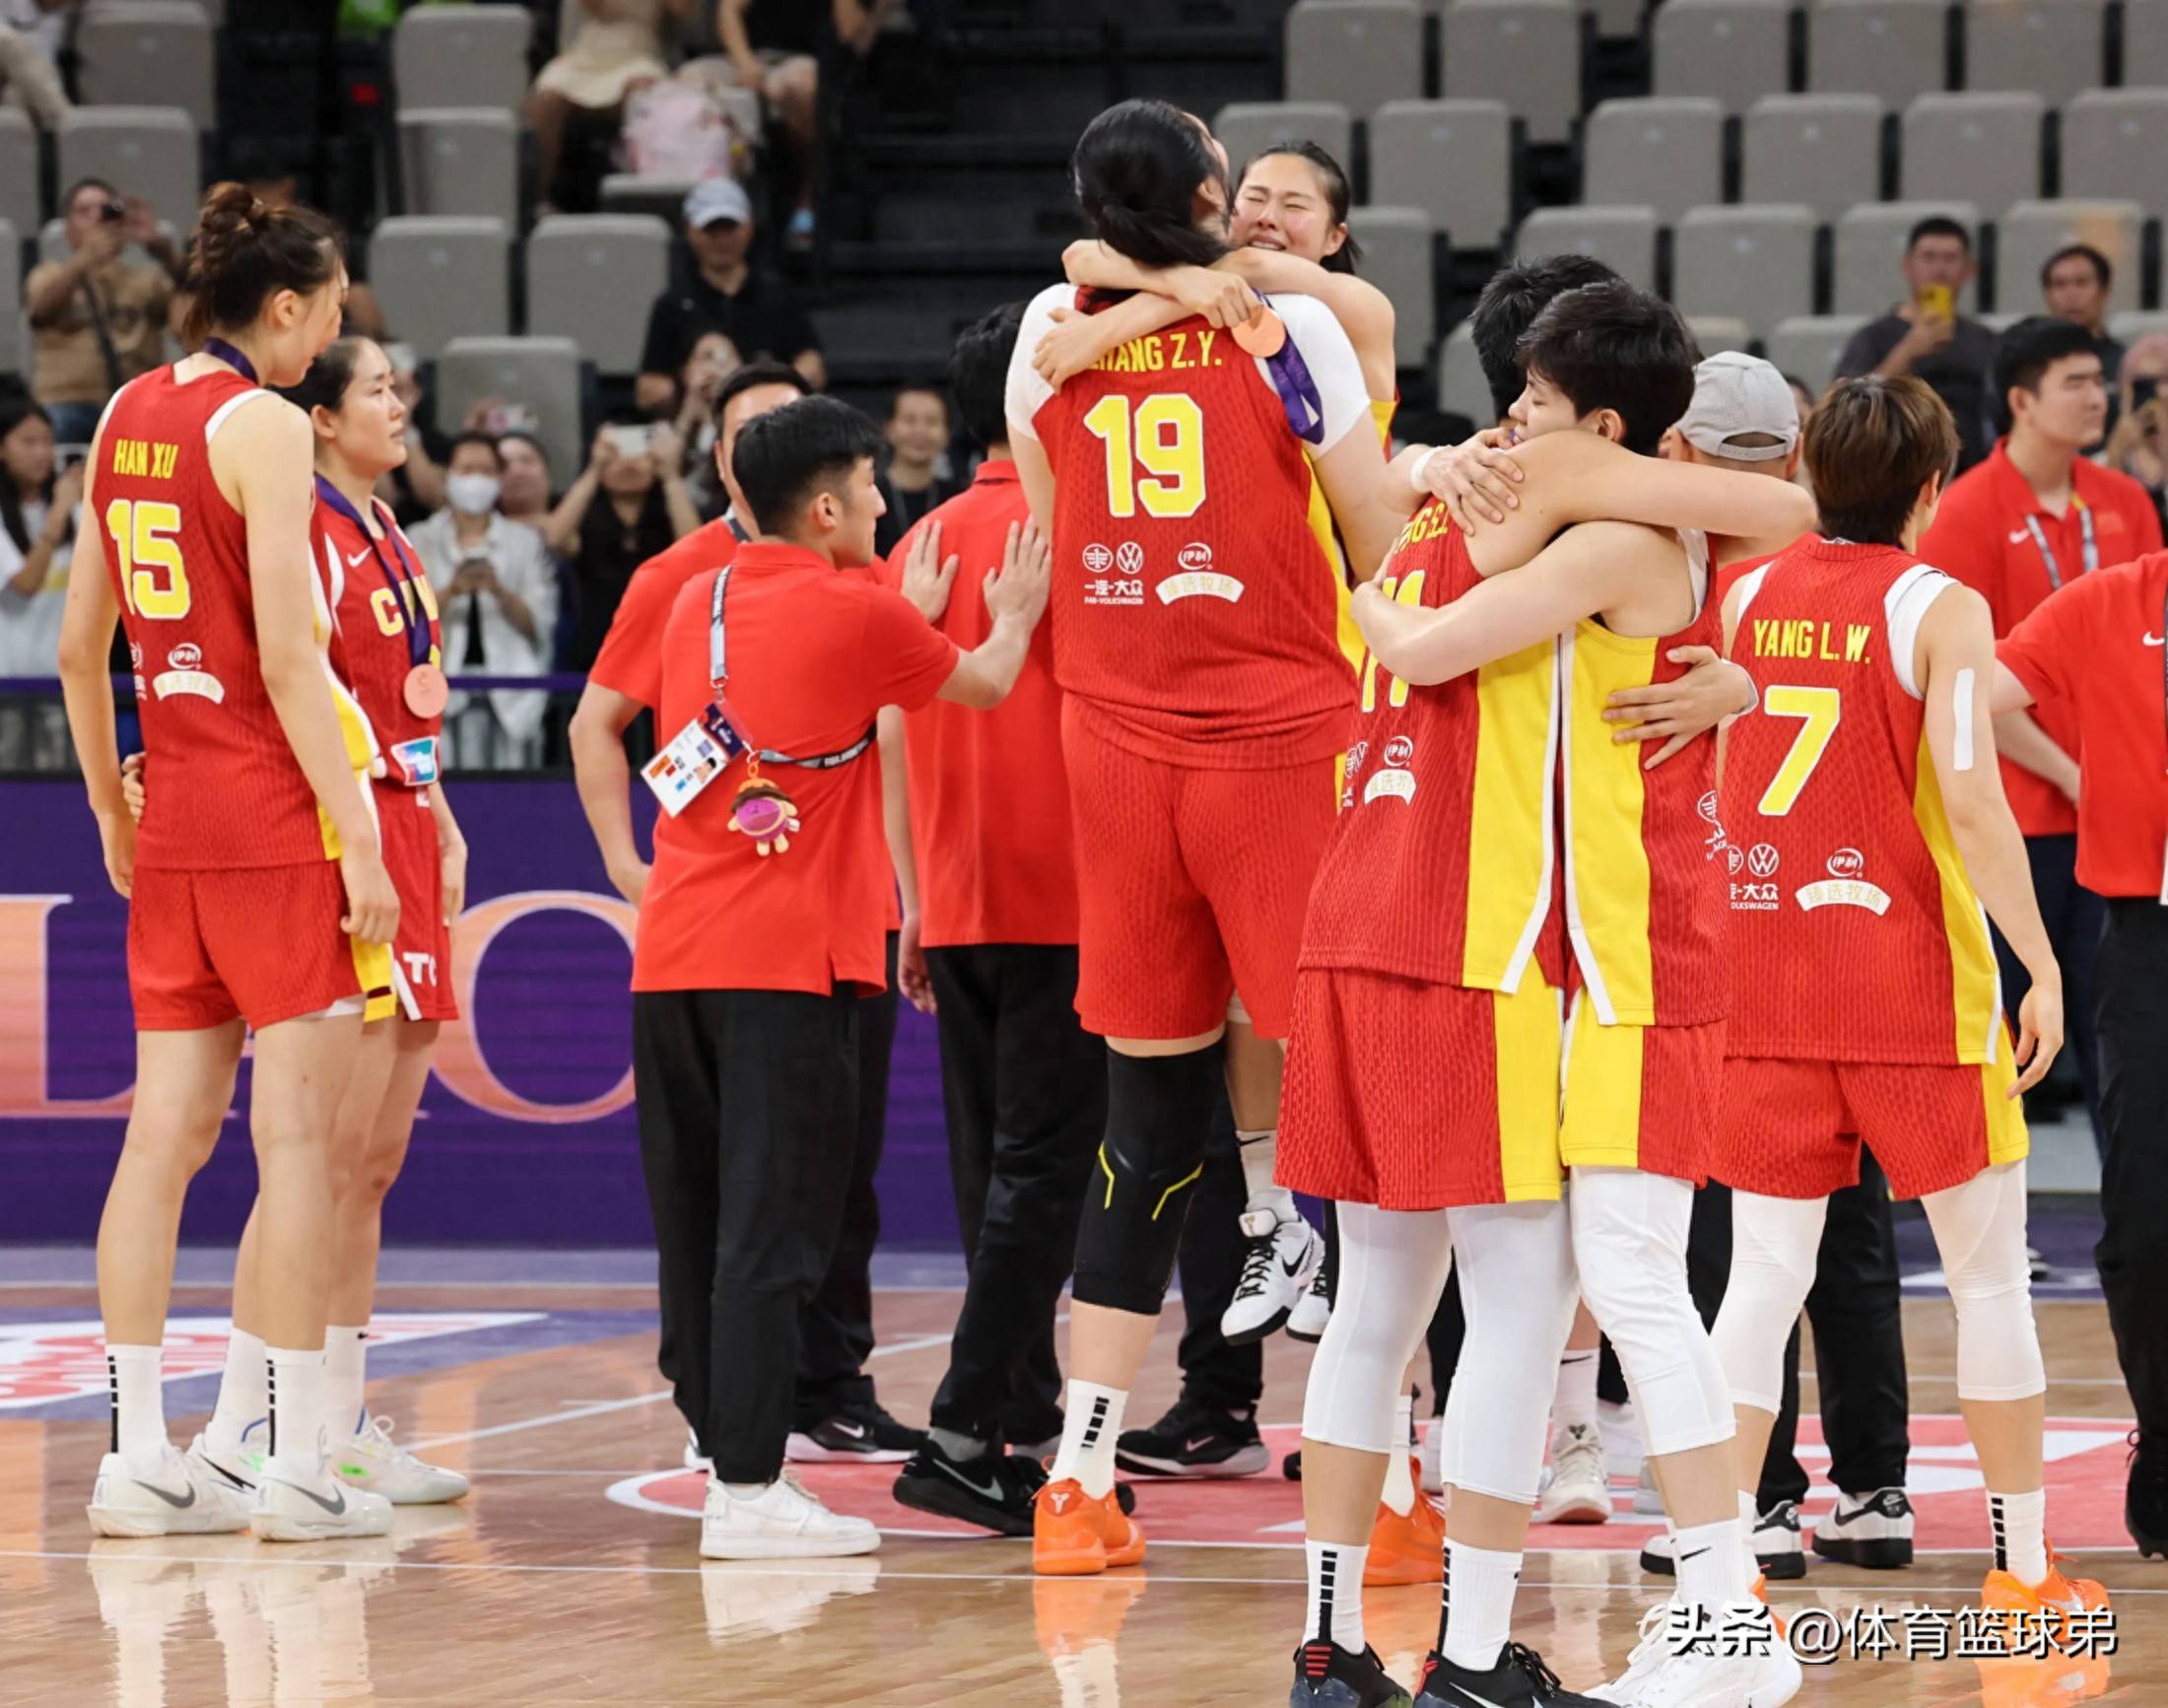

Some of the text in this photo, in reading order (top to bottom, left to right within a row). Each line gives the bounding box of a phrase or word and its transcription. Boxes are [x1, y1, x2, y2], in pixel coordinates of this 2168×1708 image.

[1088, 330, 1222, 372] HANG Z.Y.
[112, 439, 178, 479] HAN XU
[1083, 392, 1206, 517] 19
[105, 498, 191, 620] 15
[1753, 619, 1814, 657] YANG
[1757, 684, 1841, 816] 7
